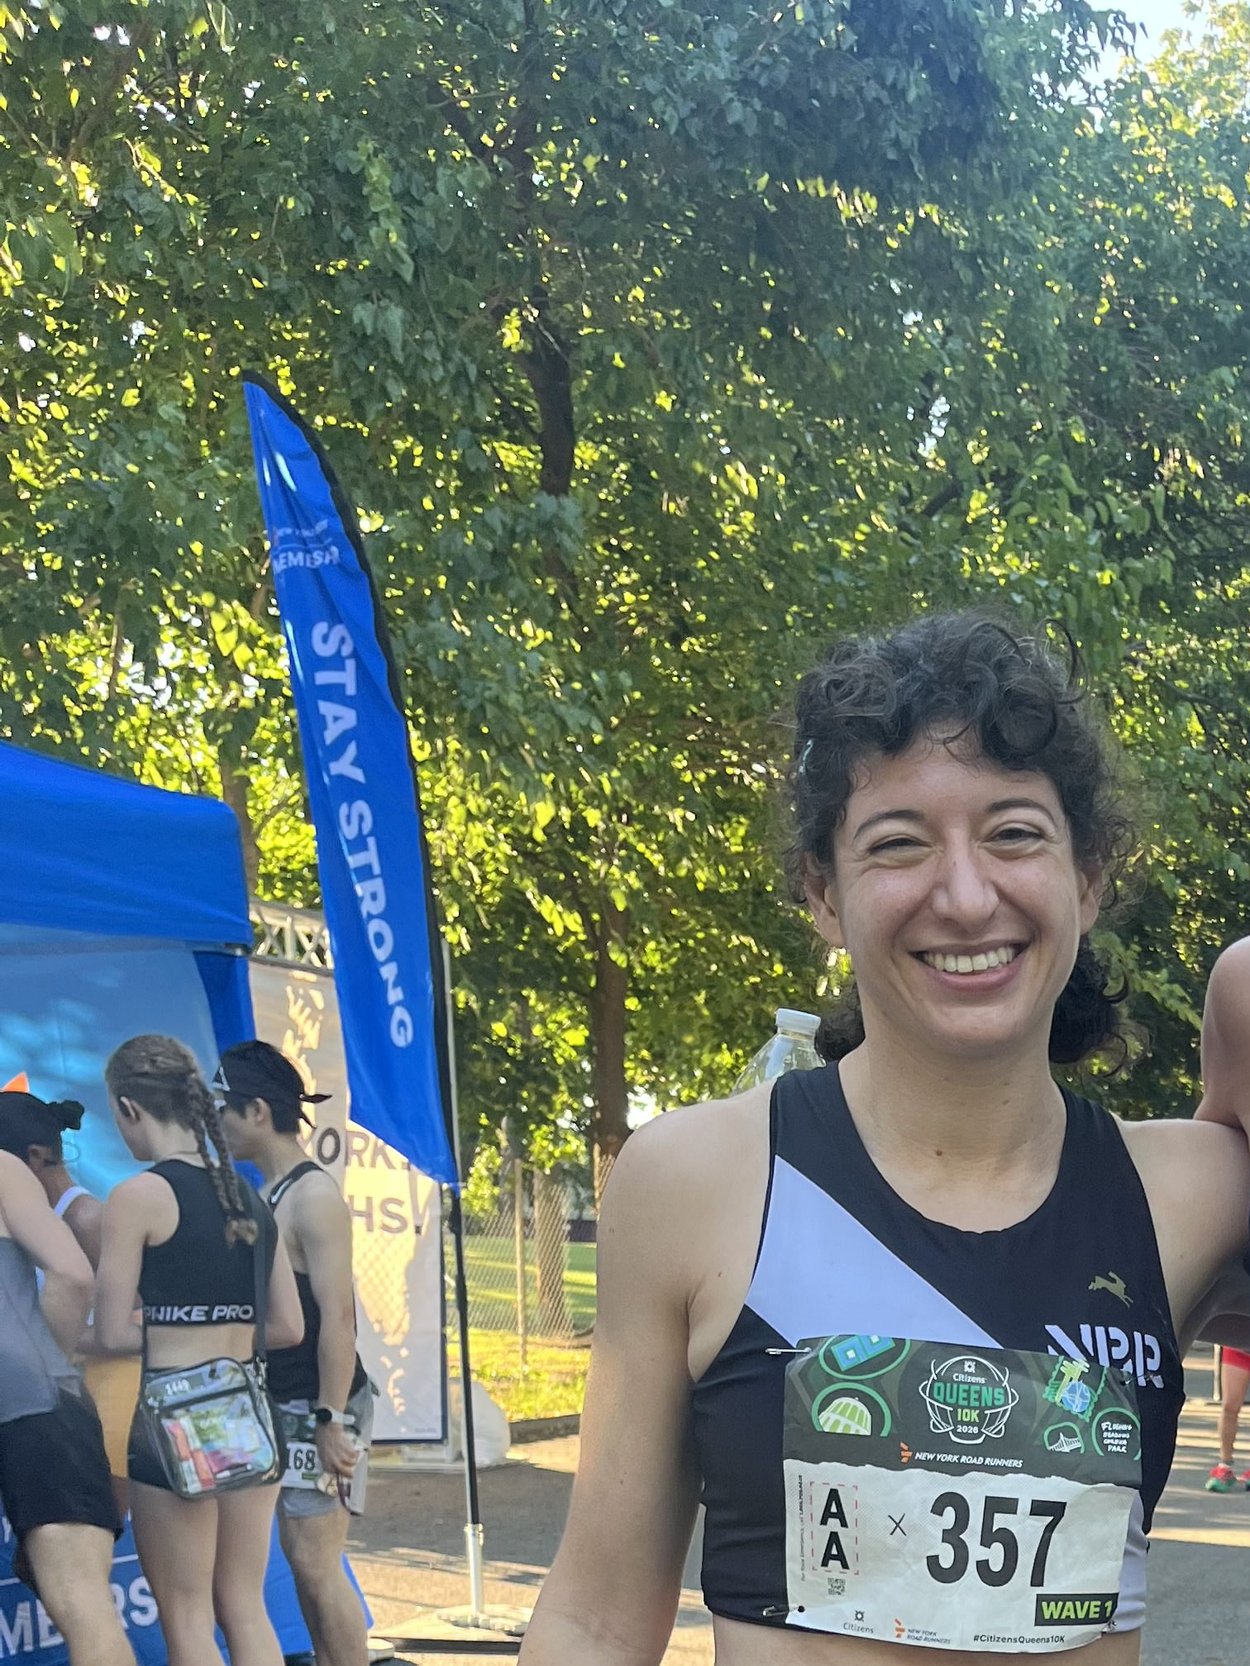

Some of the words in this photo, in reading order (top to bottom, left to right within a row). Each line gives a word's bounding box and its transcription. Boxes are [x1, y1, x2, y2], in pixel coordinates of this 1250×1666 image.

[312, 621, 366, 784] STAY
[338, 800, 414, 1049] STRONG
[212, 1304, 254, 1321] PRO
[952, 1373, 986, 1384] Citizens
[933, 1382, 1005, 1407] QUEENS
[957, 1408, 980, 1422] 10K
[914, 1452, 936, 1461] NEW
[936, 1453, 960, 1463] YORK
[960, 1455, 984, 1465] ROAD
[984, 1457, 1024, 1468] RUNNERS
[925, 1490, 1067, 1588] 357
[1041, 1600, 1101, 1620] WAVE
[1104, 1600, 1113, 1617] 1
[842, 1622, 874, 1634] Citizens
[973, 1634, 1066, 1644] #CitizensQueens10K
